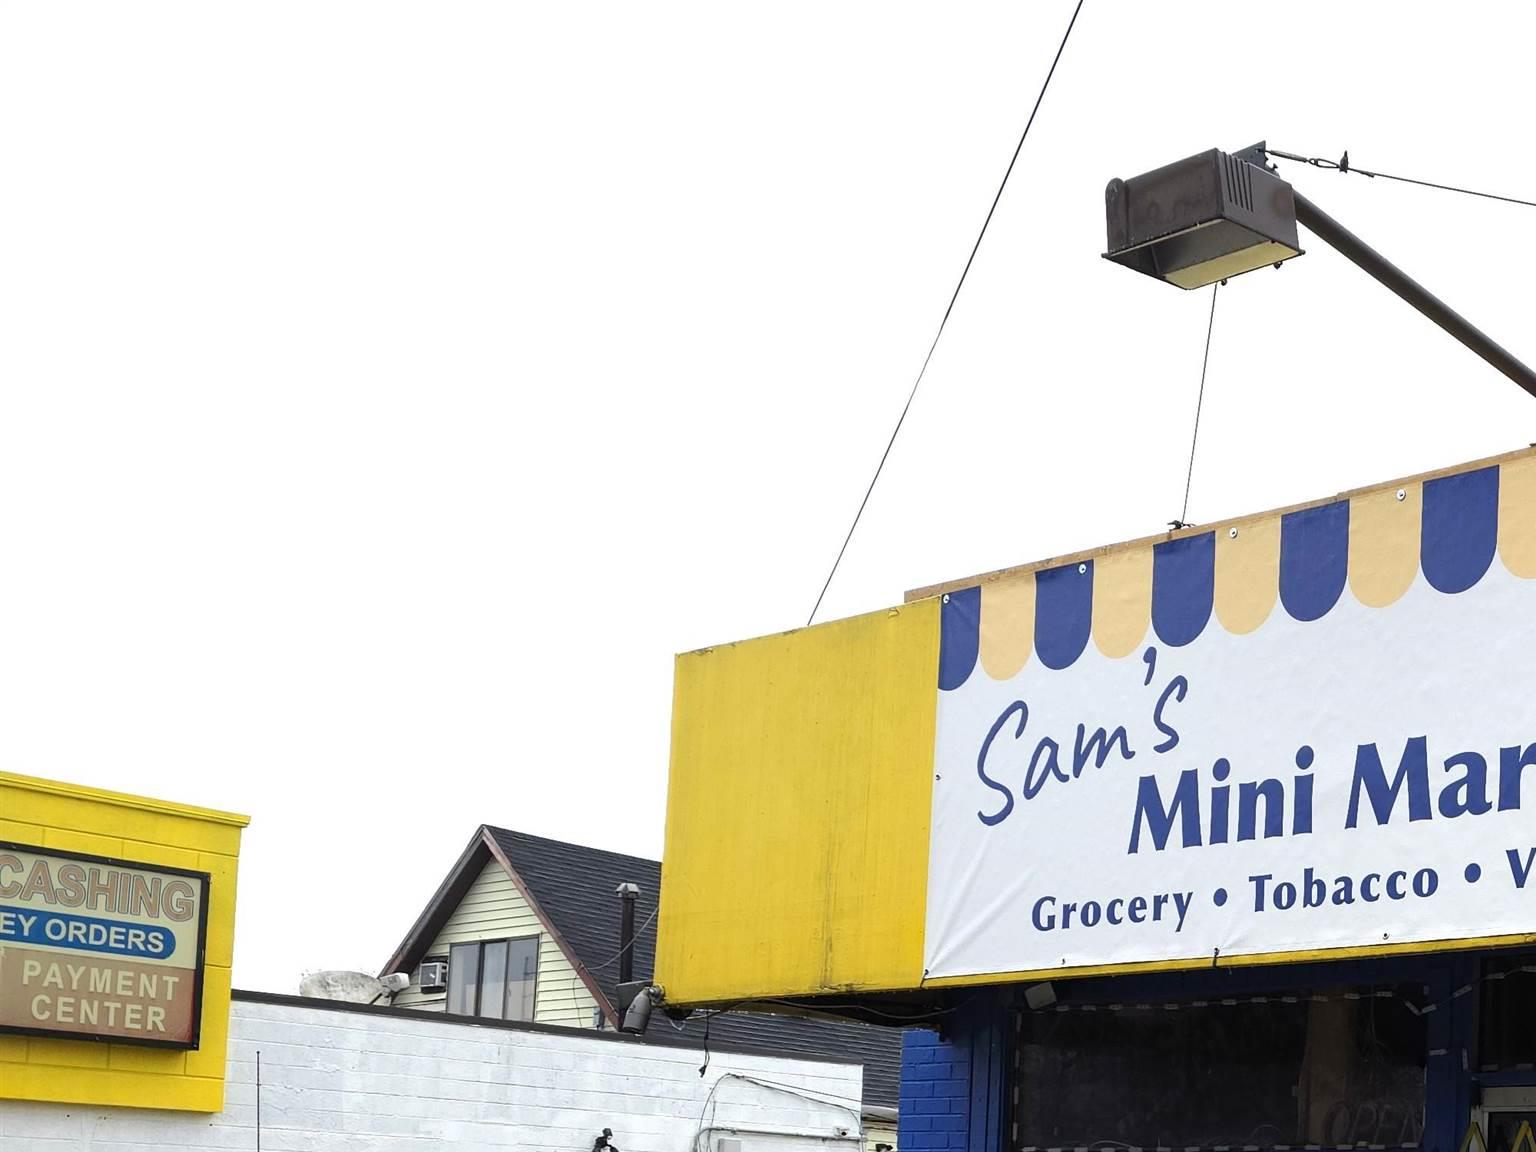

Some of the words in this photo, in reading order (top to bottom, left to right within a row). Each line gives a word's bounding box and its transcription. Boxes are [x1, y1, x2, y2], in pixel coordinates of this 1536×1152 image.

[977, 646, 1188, 826] Sam's
[1128, 745, 1315, 855] Mini
[0, 854, 195, 923] CASHING
[1032, 891, 1193, 932] Grocery
[1249, 866, 1439, 913] Tobacco
[45, 918, 164, 953] ORDERS
[23, 959, 180, 1001] PAYMENT
[31, 994, 166, 1032] CENTER
